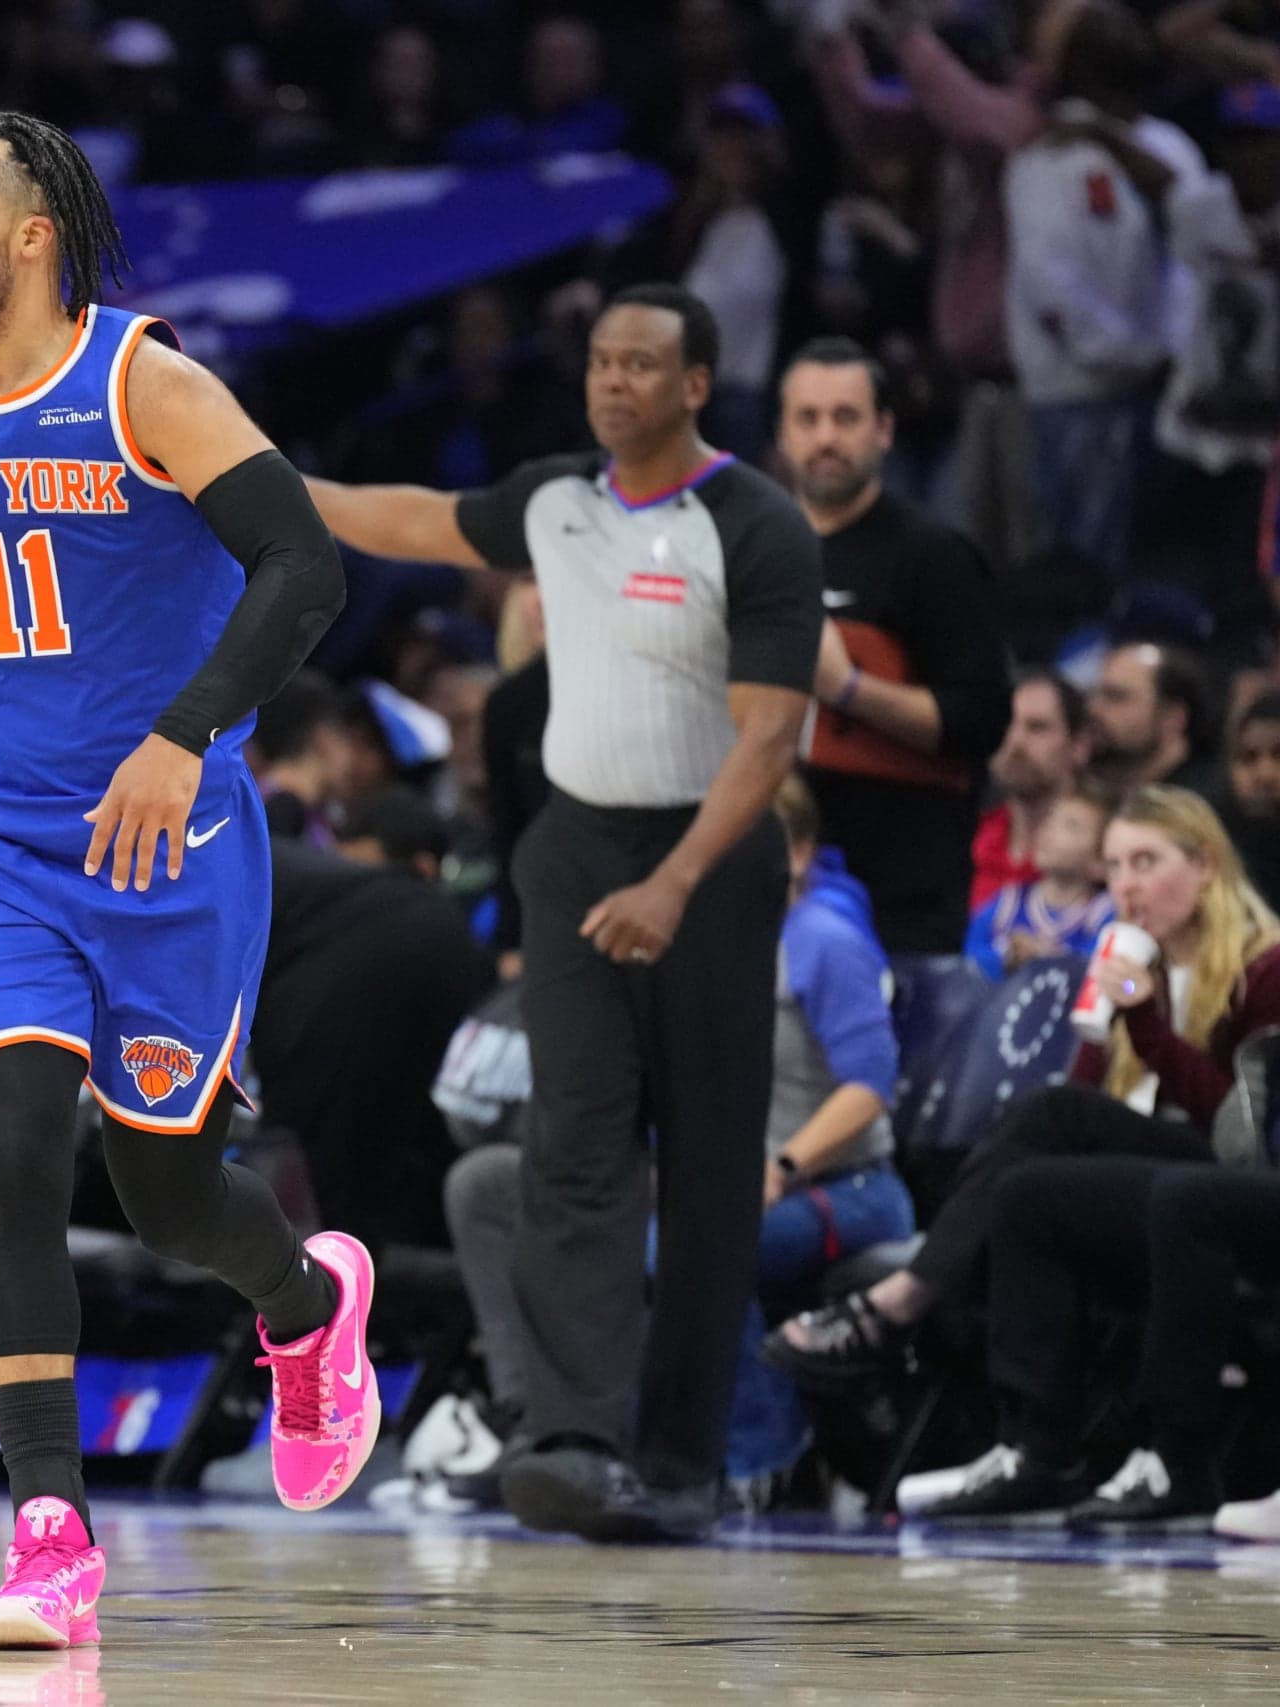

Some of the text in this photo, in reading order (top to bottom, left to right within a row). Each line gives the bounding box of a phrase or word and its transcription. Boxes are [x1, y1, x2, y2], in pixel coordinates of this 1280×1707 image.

[38, 408, 103, 426] abu dhabi
[122, 1039, 194, 1078] KNICKS
